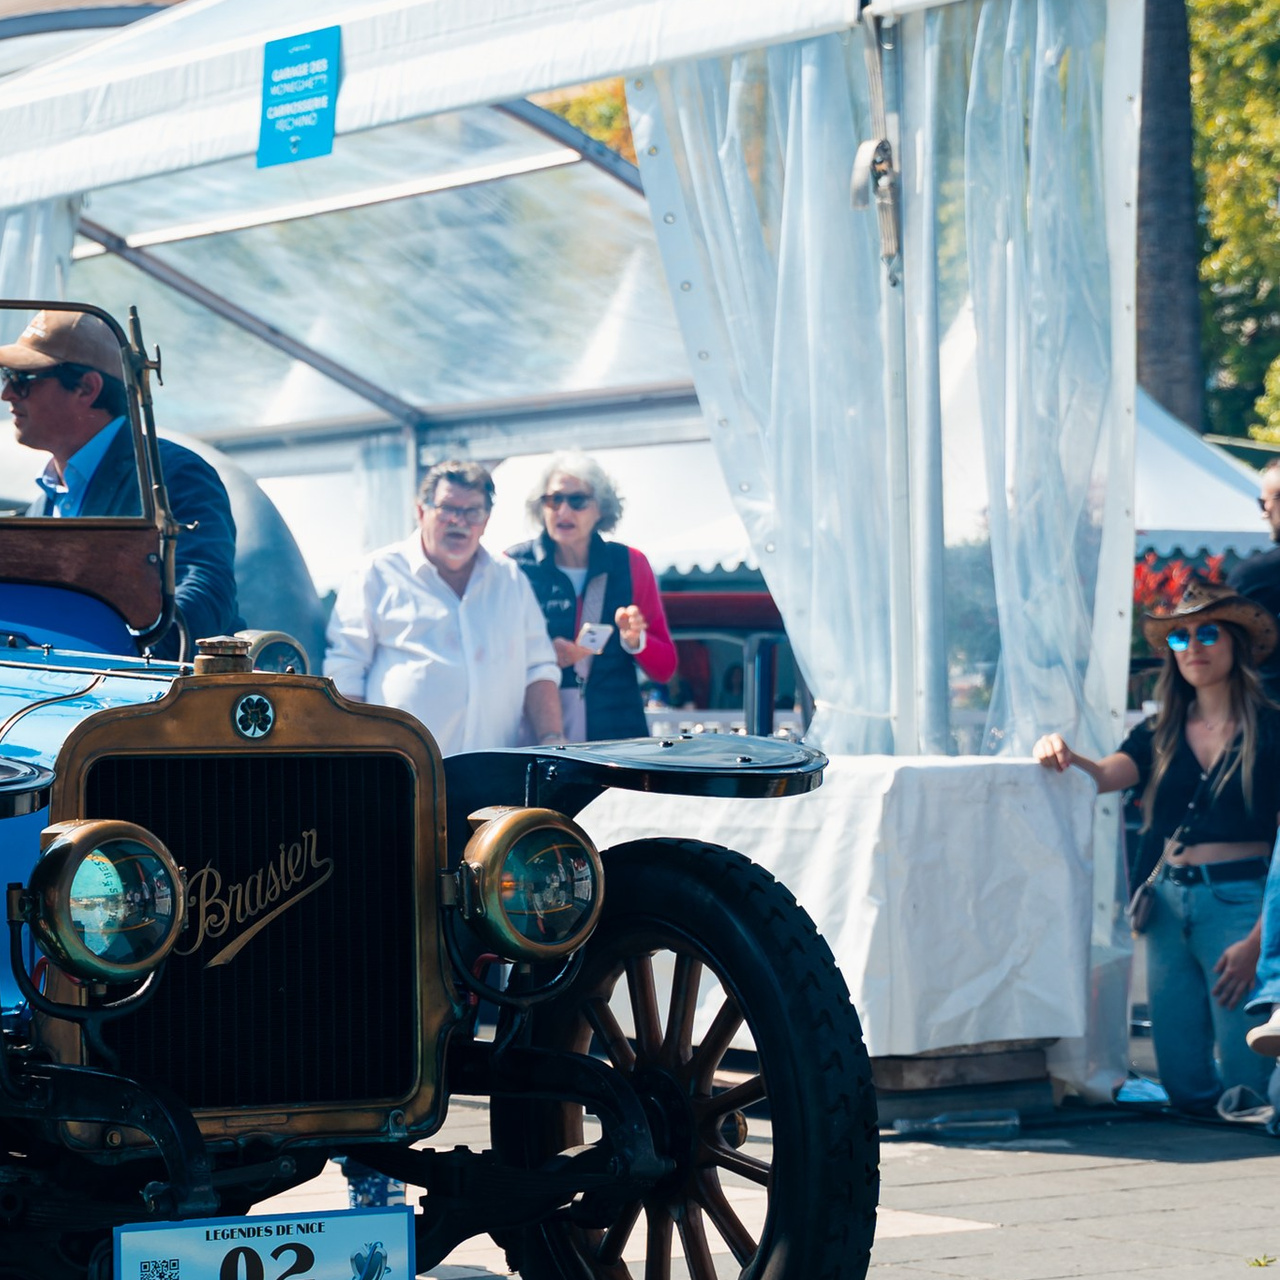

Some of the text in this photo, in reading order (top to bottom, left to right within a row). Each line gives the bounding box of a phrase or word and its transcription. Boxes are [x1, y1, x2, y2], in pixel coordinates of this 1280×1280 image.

[174, 828, 333, 958] Brasier
[205, 1221, 325, 1241] LEGENDES DE NICE
